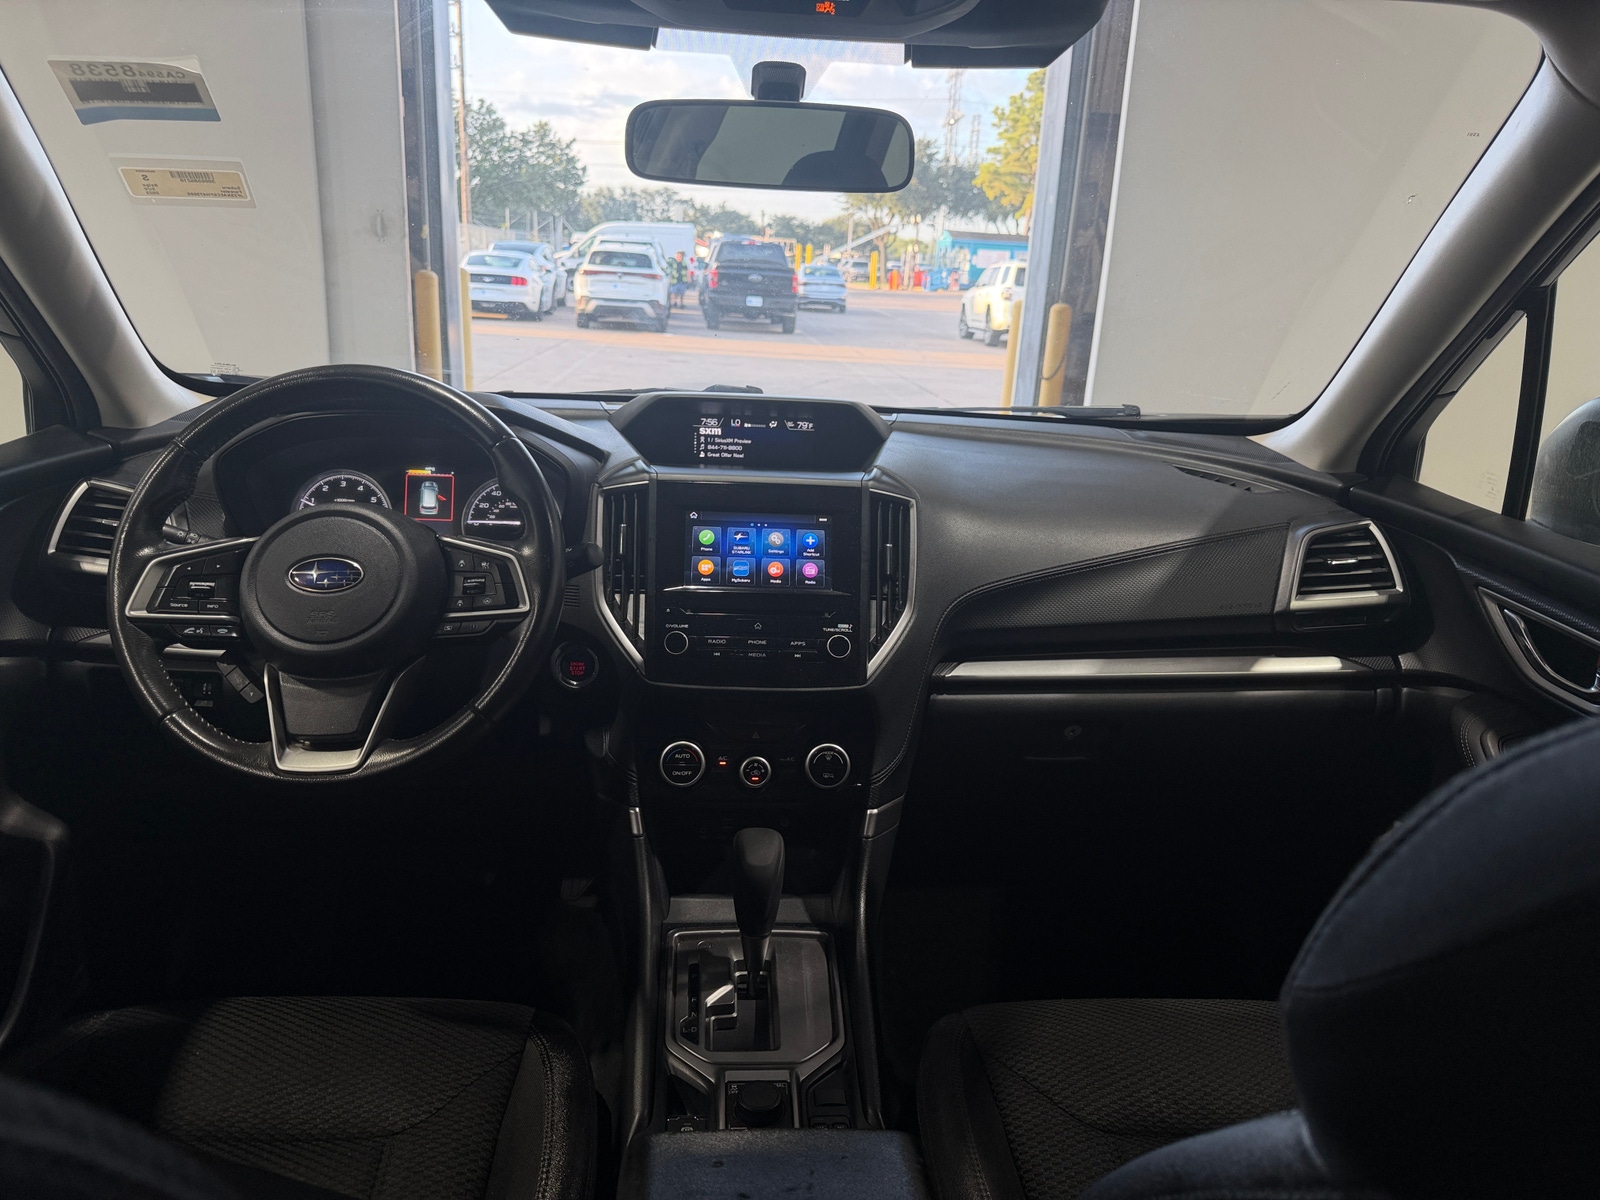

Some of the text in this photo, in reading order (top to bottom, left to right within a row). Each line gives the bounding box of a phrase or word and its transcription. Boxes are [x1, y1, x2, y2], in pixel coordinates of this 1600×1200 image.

[699, 427, 722, 436] sxm
[340, 480, 347, 488] 3
[370, 496, 377, 504] 5
